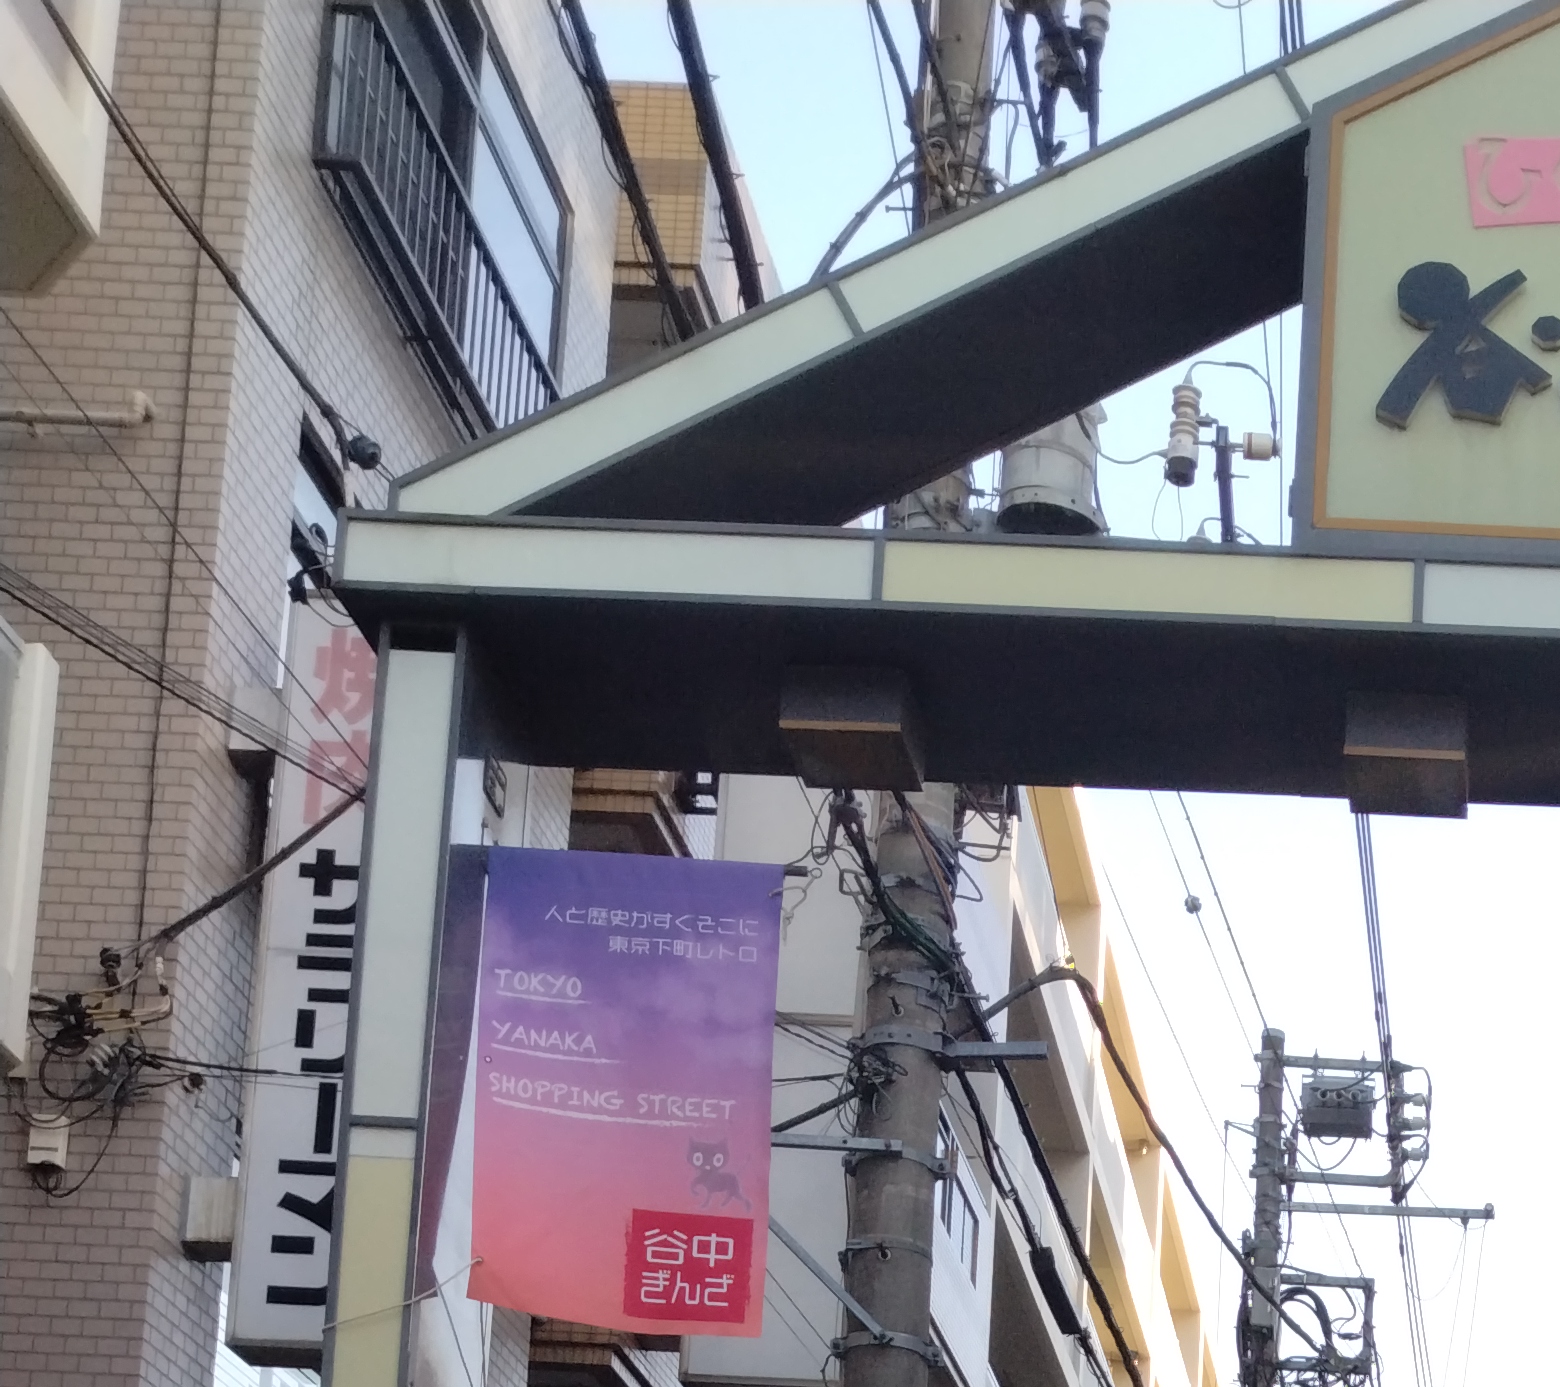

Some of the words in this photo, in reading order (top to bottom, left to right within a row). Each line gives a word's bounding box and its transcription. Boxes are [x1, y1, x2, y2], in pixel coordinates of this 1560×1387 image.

[545, 905, 760, 938] 人と歴史がすぐそこに
[608, 935, 758, 963] 東京下町レトロ
[495, 967, 582, 998] TOKYO
[492, 1021, 598, 1054] YANAKA
[489, 1072, 624, 1112] SHOPPING
[639, 1093, 737, 1121] STREET
[643, 1228, 735, 1268] 谷中
[640, 1268, 735, 1308] ぎんざ
